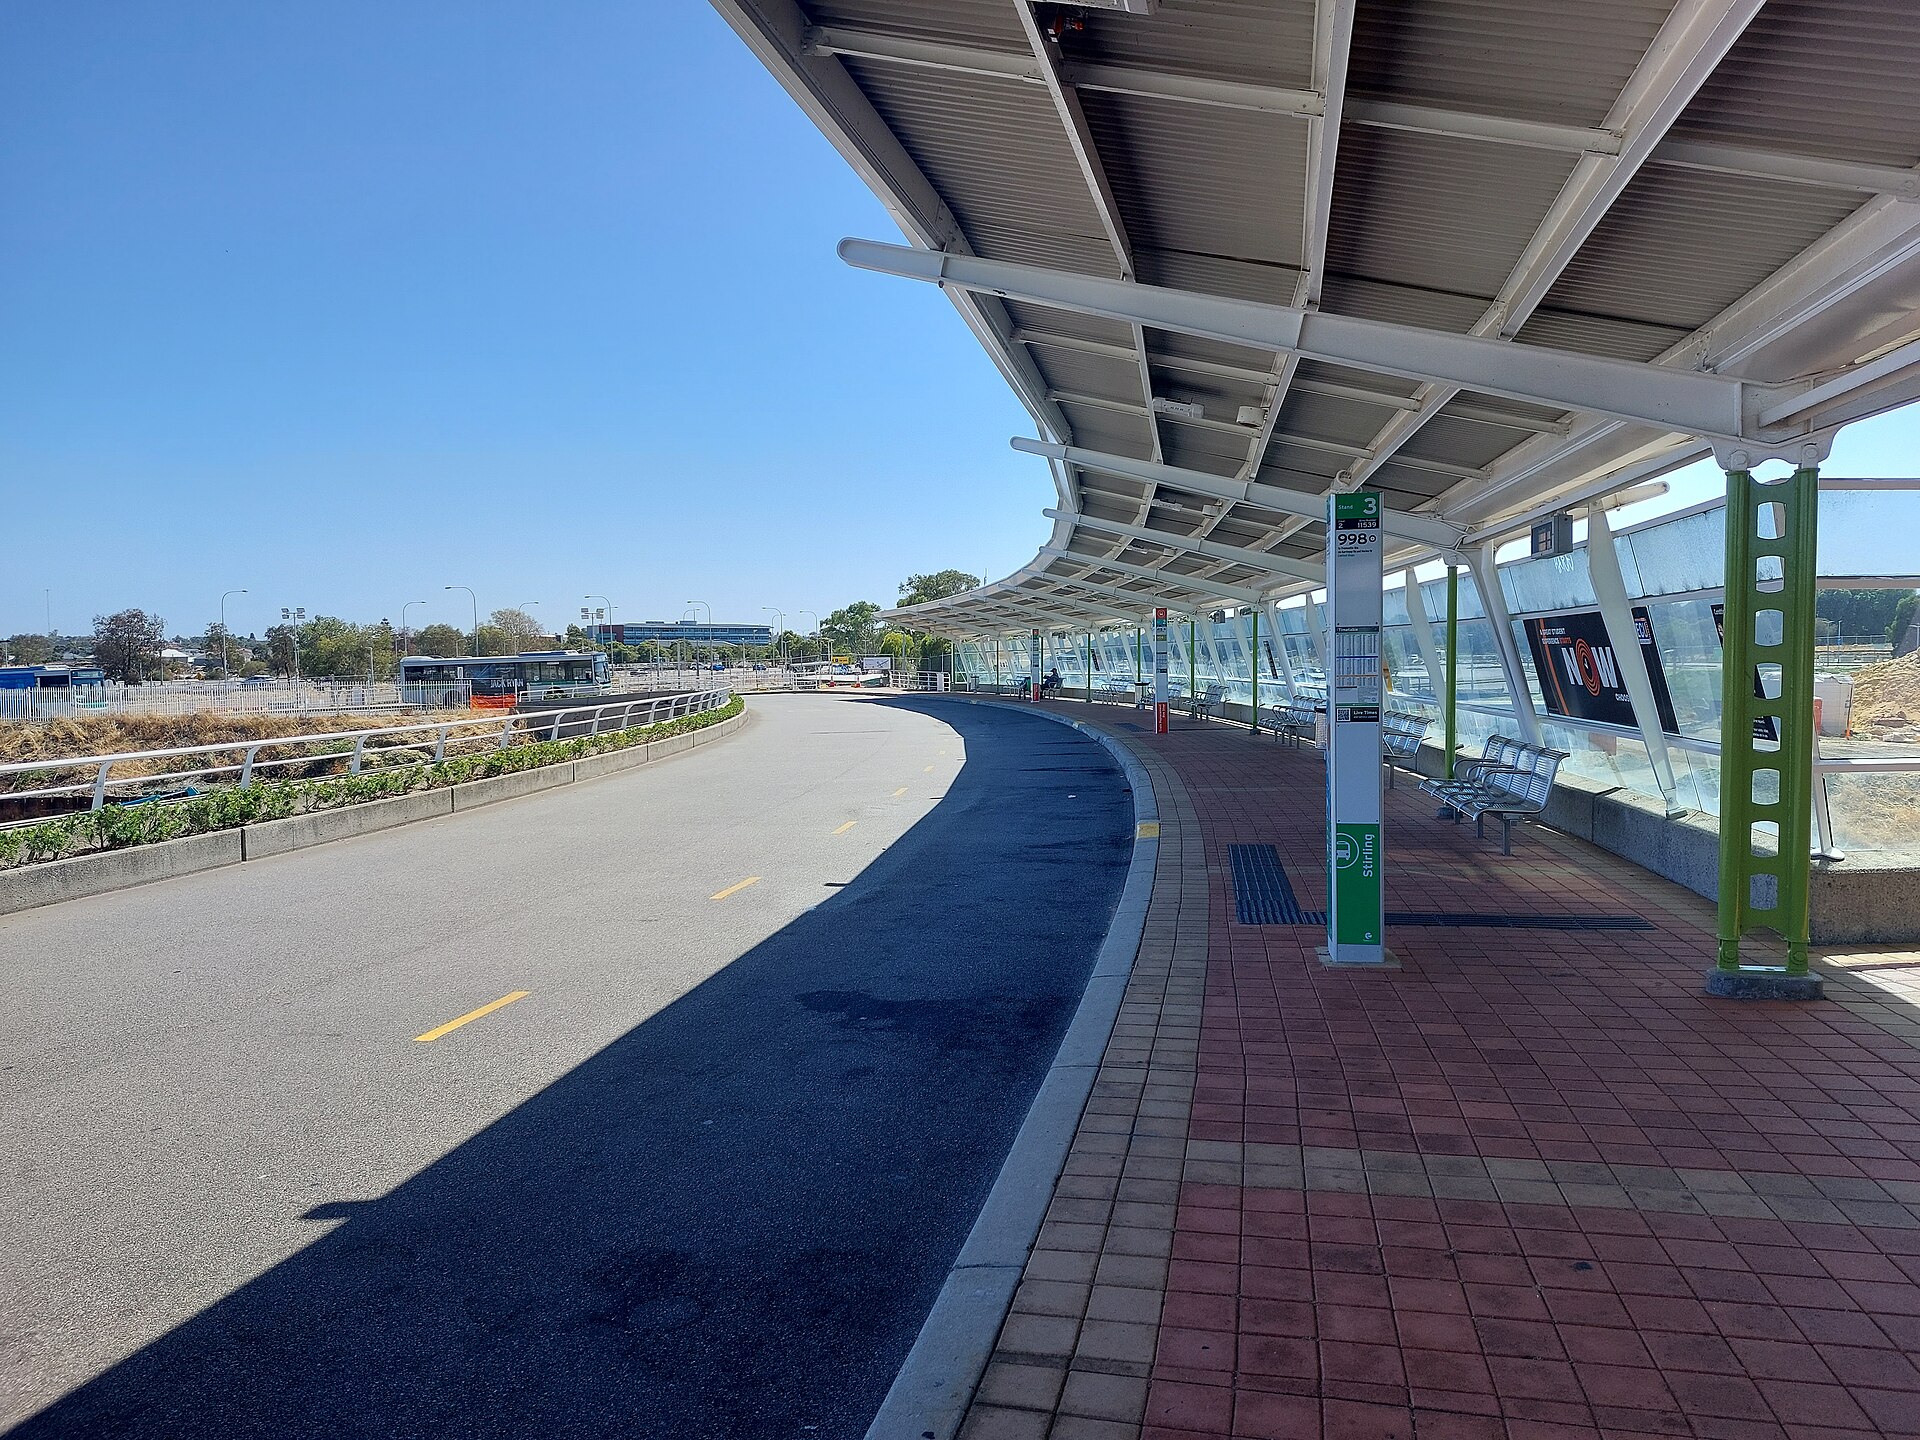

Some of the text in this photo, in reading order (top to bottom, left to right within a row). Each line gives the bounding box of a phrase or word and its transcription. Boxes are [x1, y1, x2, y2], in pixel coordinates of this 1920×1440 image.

[1363, 497, 1377, 515] 3
[1338, 533, 1367, 546] 998
[1561, 638, 1619, 697] NOW
[1363, 834, 1375, 877] Stirling
